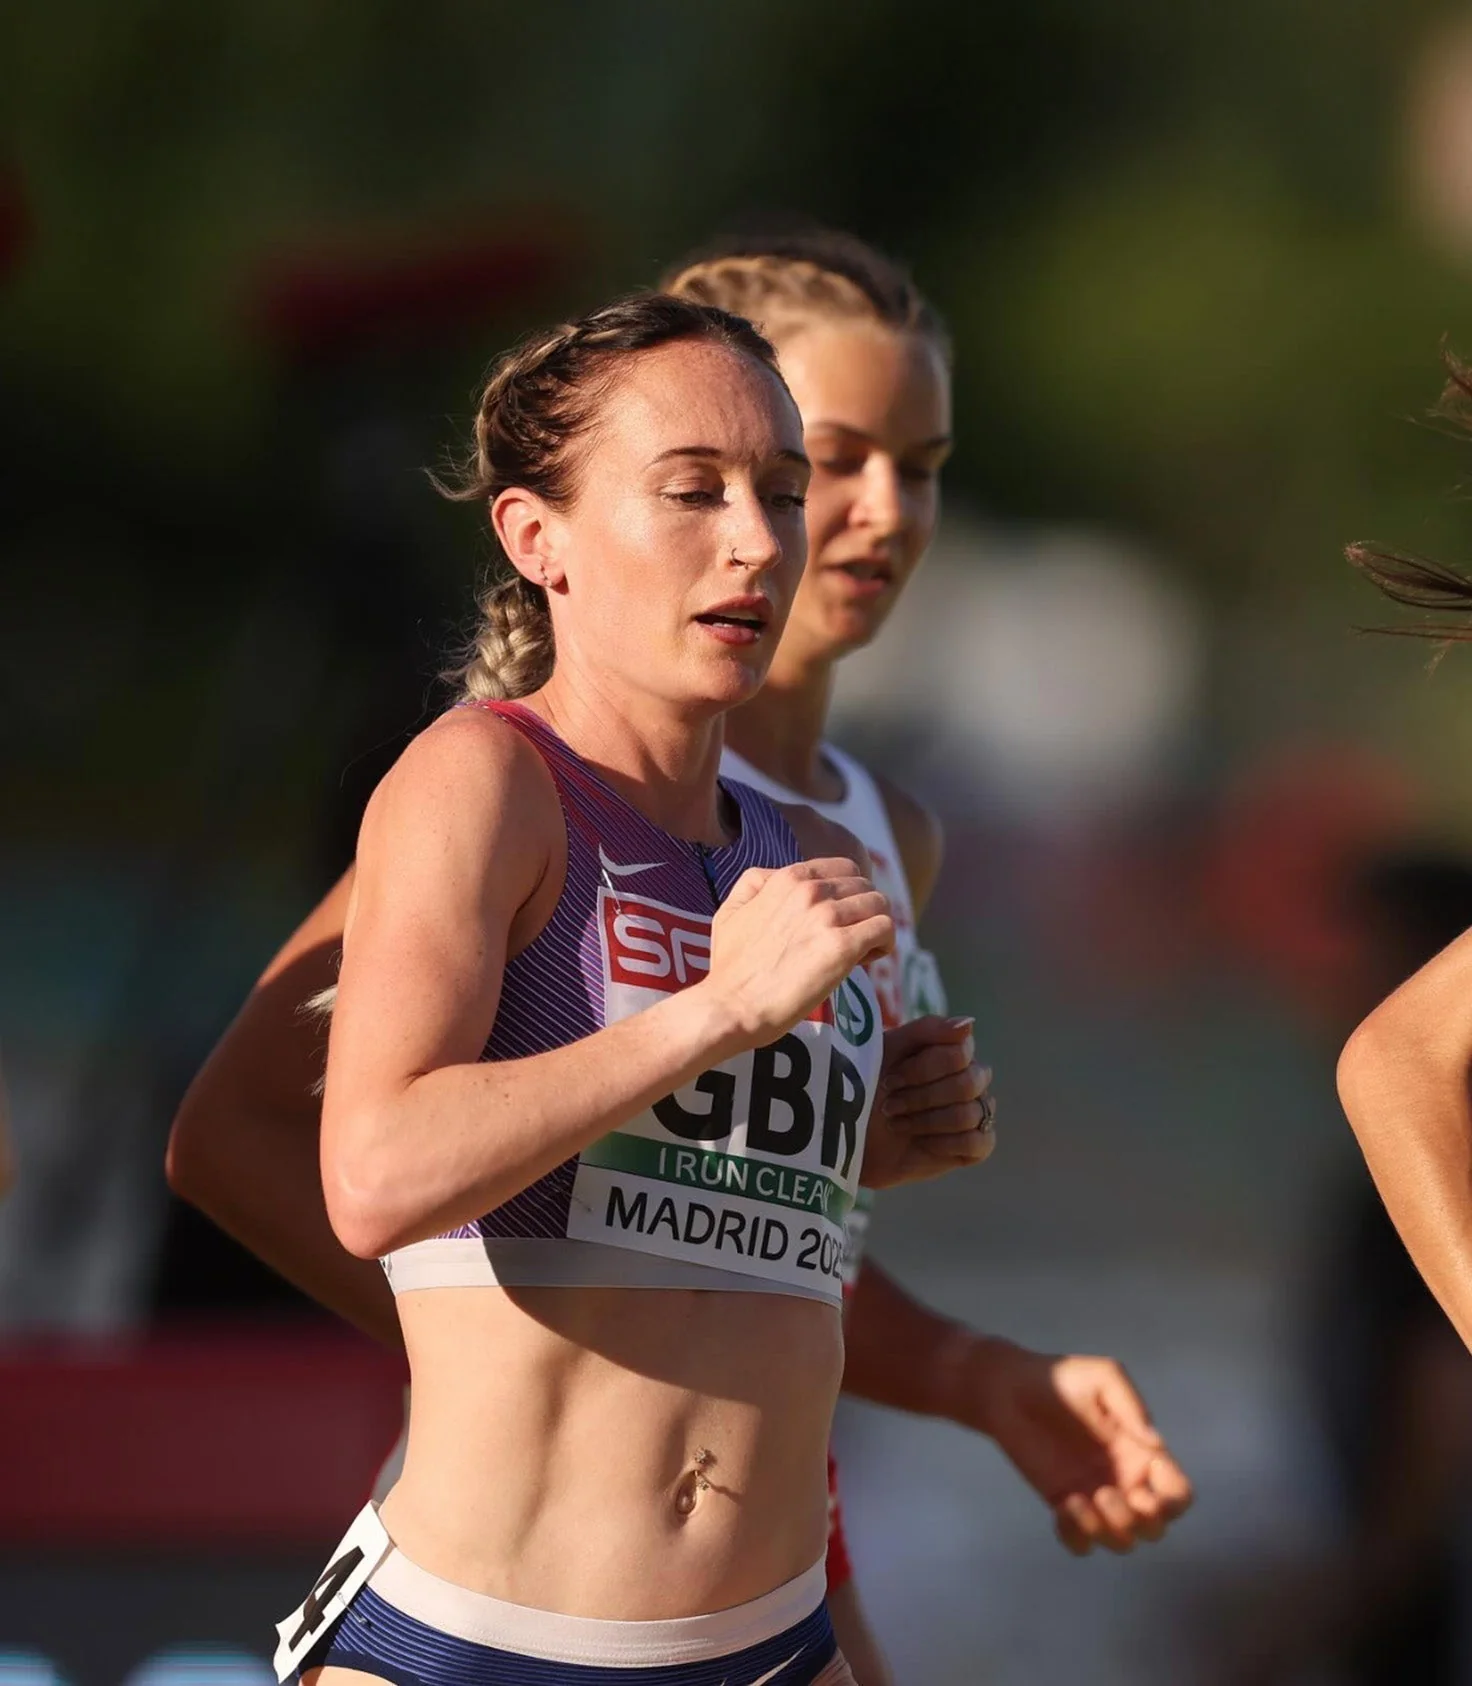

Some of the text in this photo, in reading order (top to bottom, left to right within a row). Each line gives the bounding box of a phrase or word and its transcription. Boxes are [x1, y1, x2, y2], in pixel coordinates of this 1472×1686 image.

[651, 1032, 867, 1180] GBR
[659, 1147, 668, 1176] I
[675, 1150, 749, 1191] RUN
[605, 1186, 788, 1261] MADRID
[796, 1228, 843, 1281] 202
[288, 1545, 365, 1653] 4
